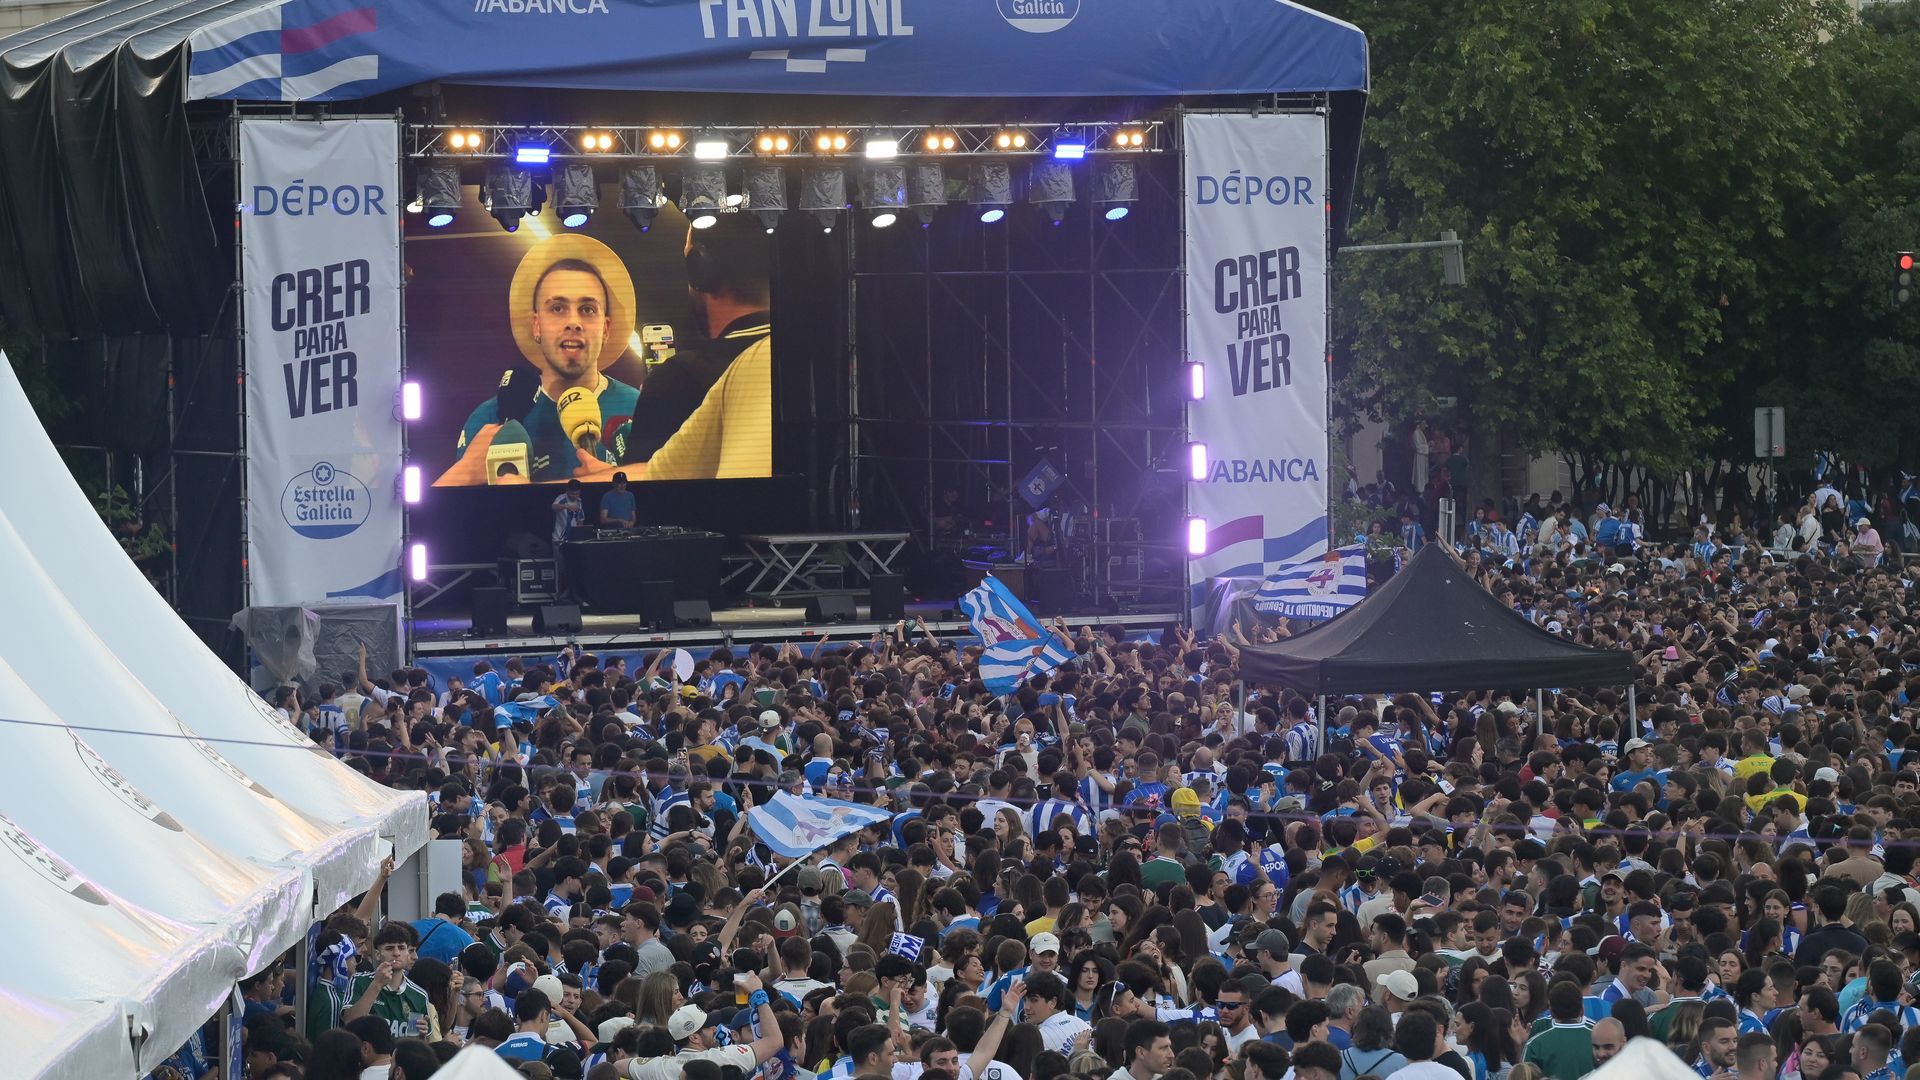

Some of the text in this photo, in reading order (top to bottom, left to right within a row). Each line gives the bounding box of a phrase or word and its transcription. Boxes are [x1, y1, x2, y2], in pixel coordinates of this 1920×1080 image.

[1012, 0, 1065, 15] Galicia
[252, 178, 388, 217] DÉPOR
[1195, 169, 1316, 206] DÉPOR
[270, 258, 371, 333] CRER
[1213, 245, 1302, 315] CRER
[293, 320, 349, 360] PARA
[1237, 304, 1282, 341] PARA
[1226, 332, 1292, 398] VER
[282, 350, 359, 420] VER
[293, 485, 356, 503] Estrella
[295, 503, 353, 522] Galicia
